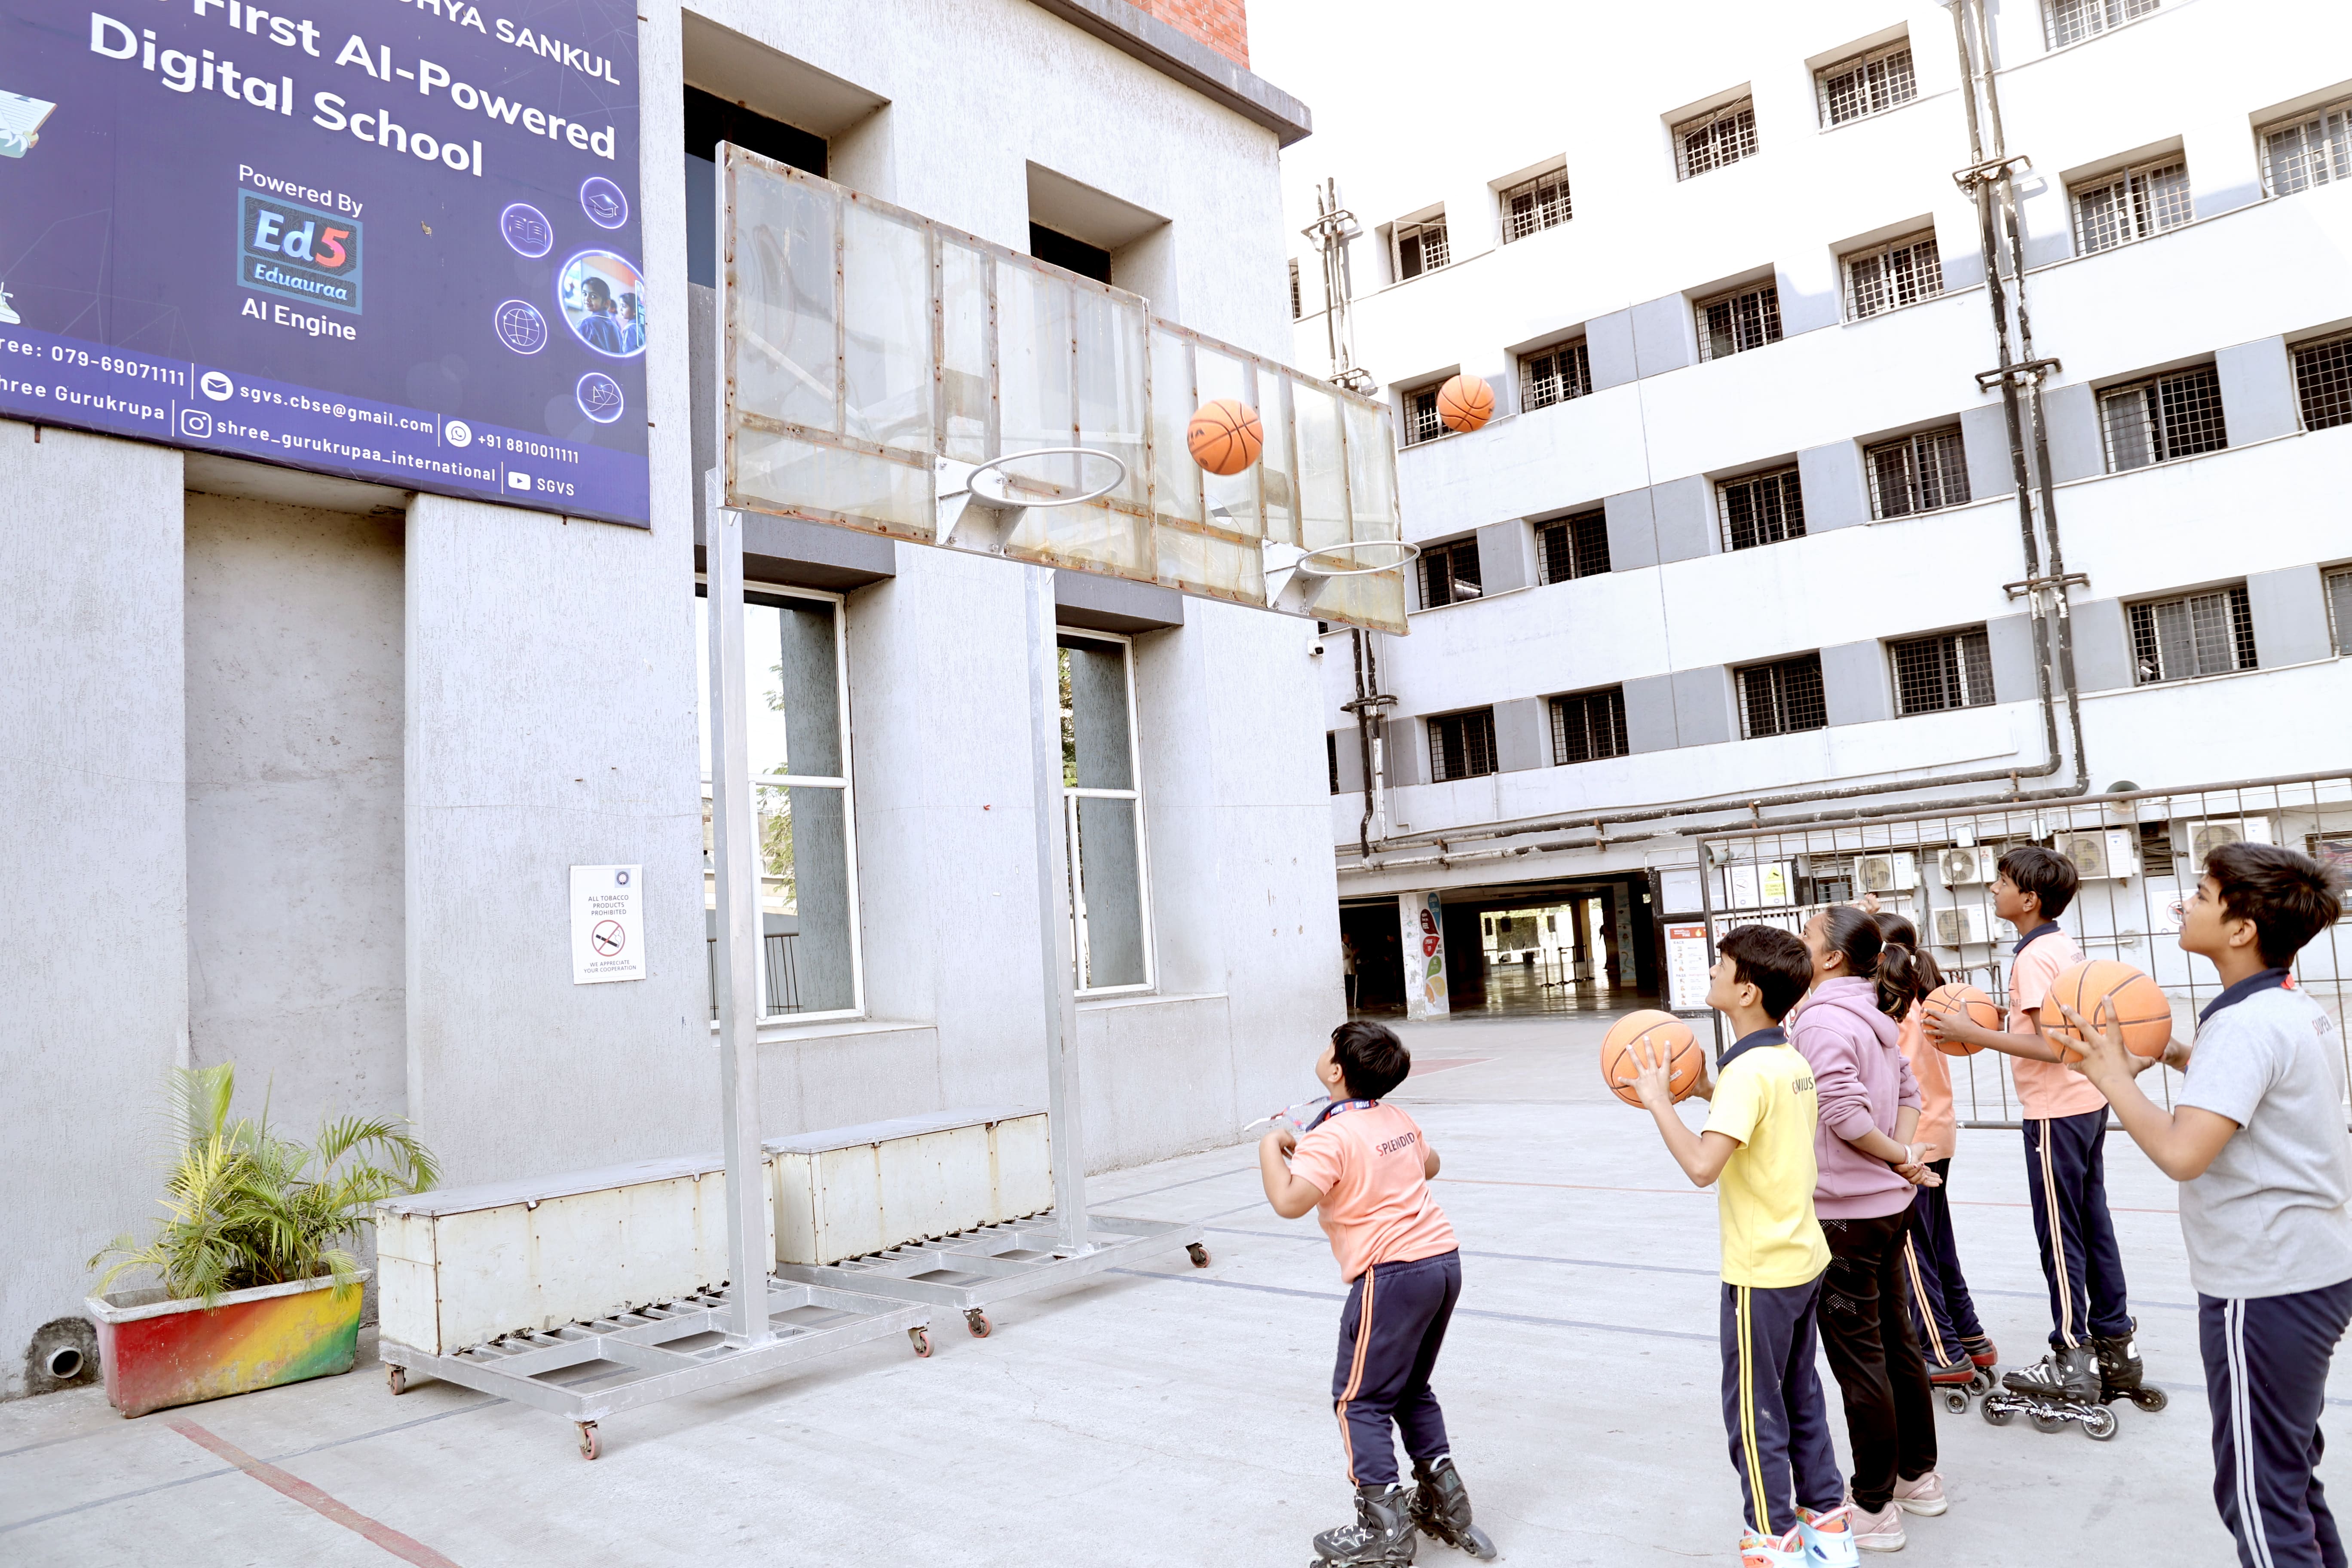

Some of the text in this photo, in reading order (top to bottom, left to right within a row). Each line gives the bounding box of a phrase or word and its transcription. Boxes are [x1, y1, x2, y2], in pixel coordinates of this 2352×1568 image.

[496, 18, 620, 86] SANKUL
[91, 12, 482, 177] Digital School
[335, 34, 615, 160] AI-Powered
[239, 164, 363, 218] Powered By
[254, 209, 349, 268] Ed5
[254, 263, 348, 301] Eduauraa
[242, 298, 356, 340] AI Engine
[52, 346, 184, 386] 079-69071111
[55, 386, 164, 420] Gurukrupa
[240, 386, 433, 434] sgvs.cbse@gmail.com
[217, 420, 495, 481] shree_gurukrupaa_international
[478, 434, 579, 464] +91 8810011111
[537, 478, 574, 496] SGVS
[1375, 1132, 1415, 1157] SPLENDID
